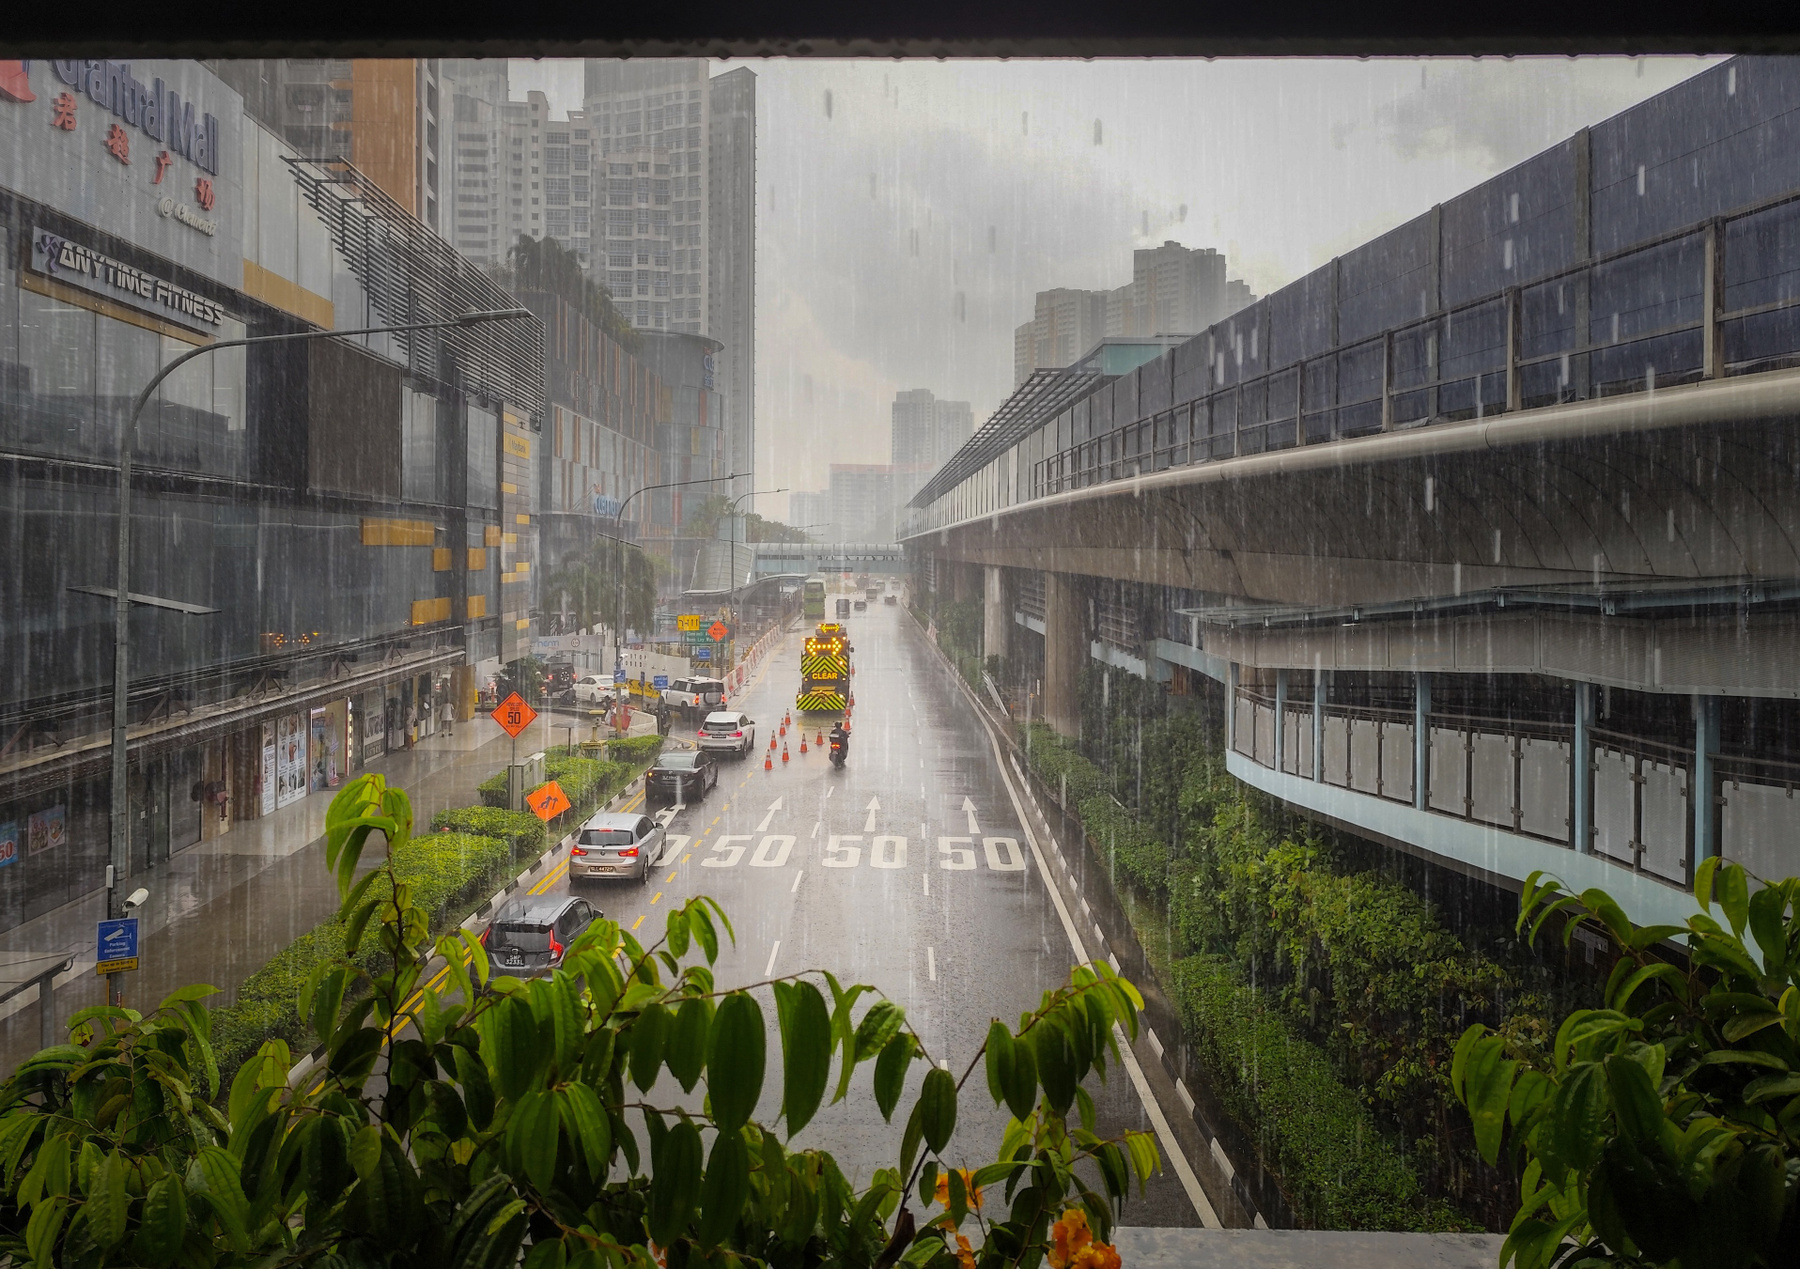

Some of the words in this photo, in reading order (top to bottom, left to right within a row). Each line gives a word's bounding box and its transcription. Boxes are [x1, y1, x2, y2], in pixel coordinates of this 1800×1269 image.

[170, 91, 219, 176] Mall
[174, 203, 217, 237] Clementi
[59, 241, 153, 298] ANYTIME
[154, 279, 225, 326] FITNESS
[812, 672, 838, 680] CLEAR
[507, 711, 521, 725] 50
[700, 834, 797, 868] 50
[822, 835, 908, 869] 50
[938, 836, 1027, 871] 50
